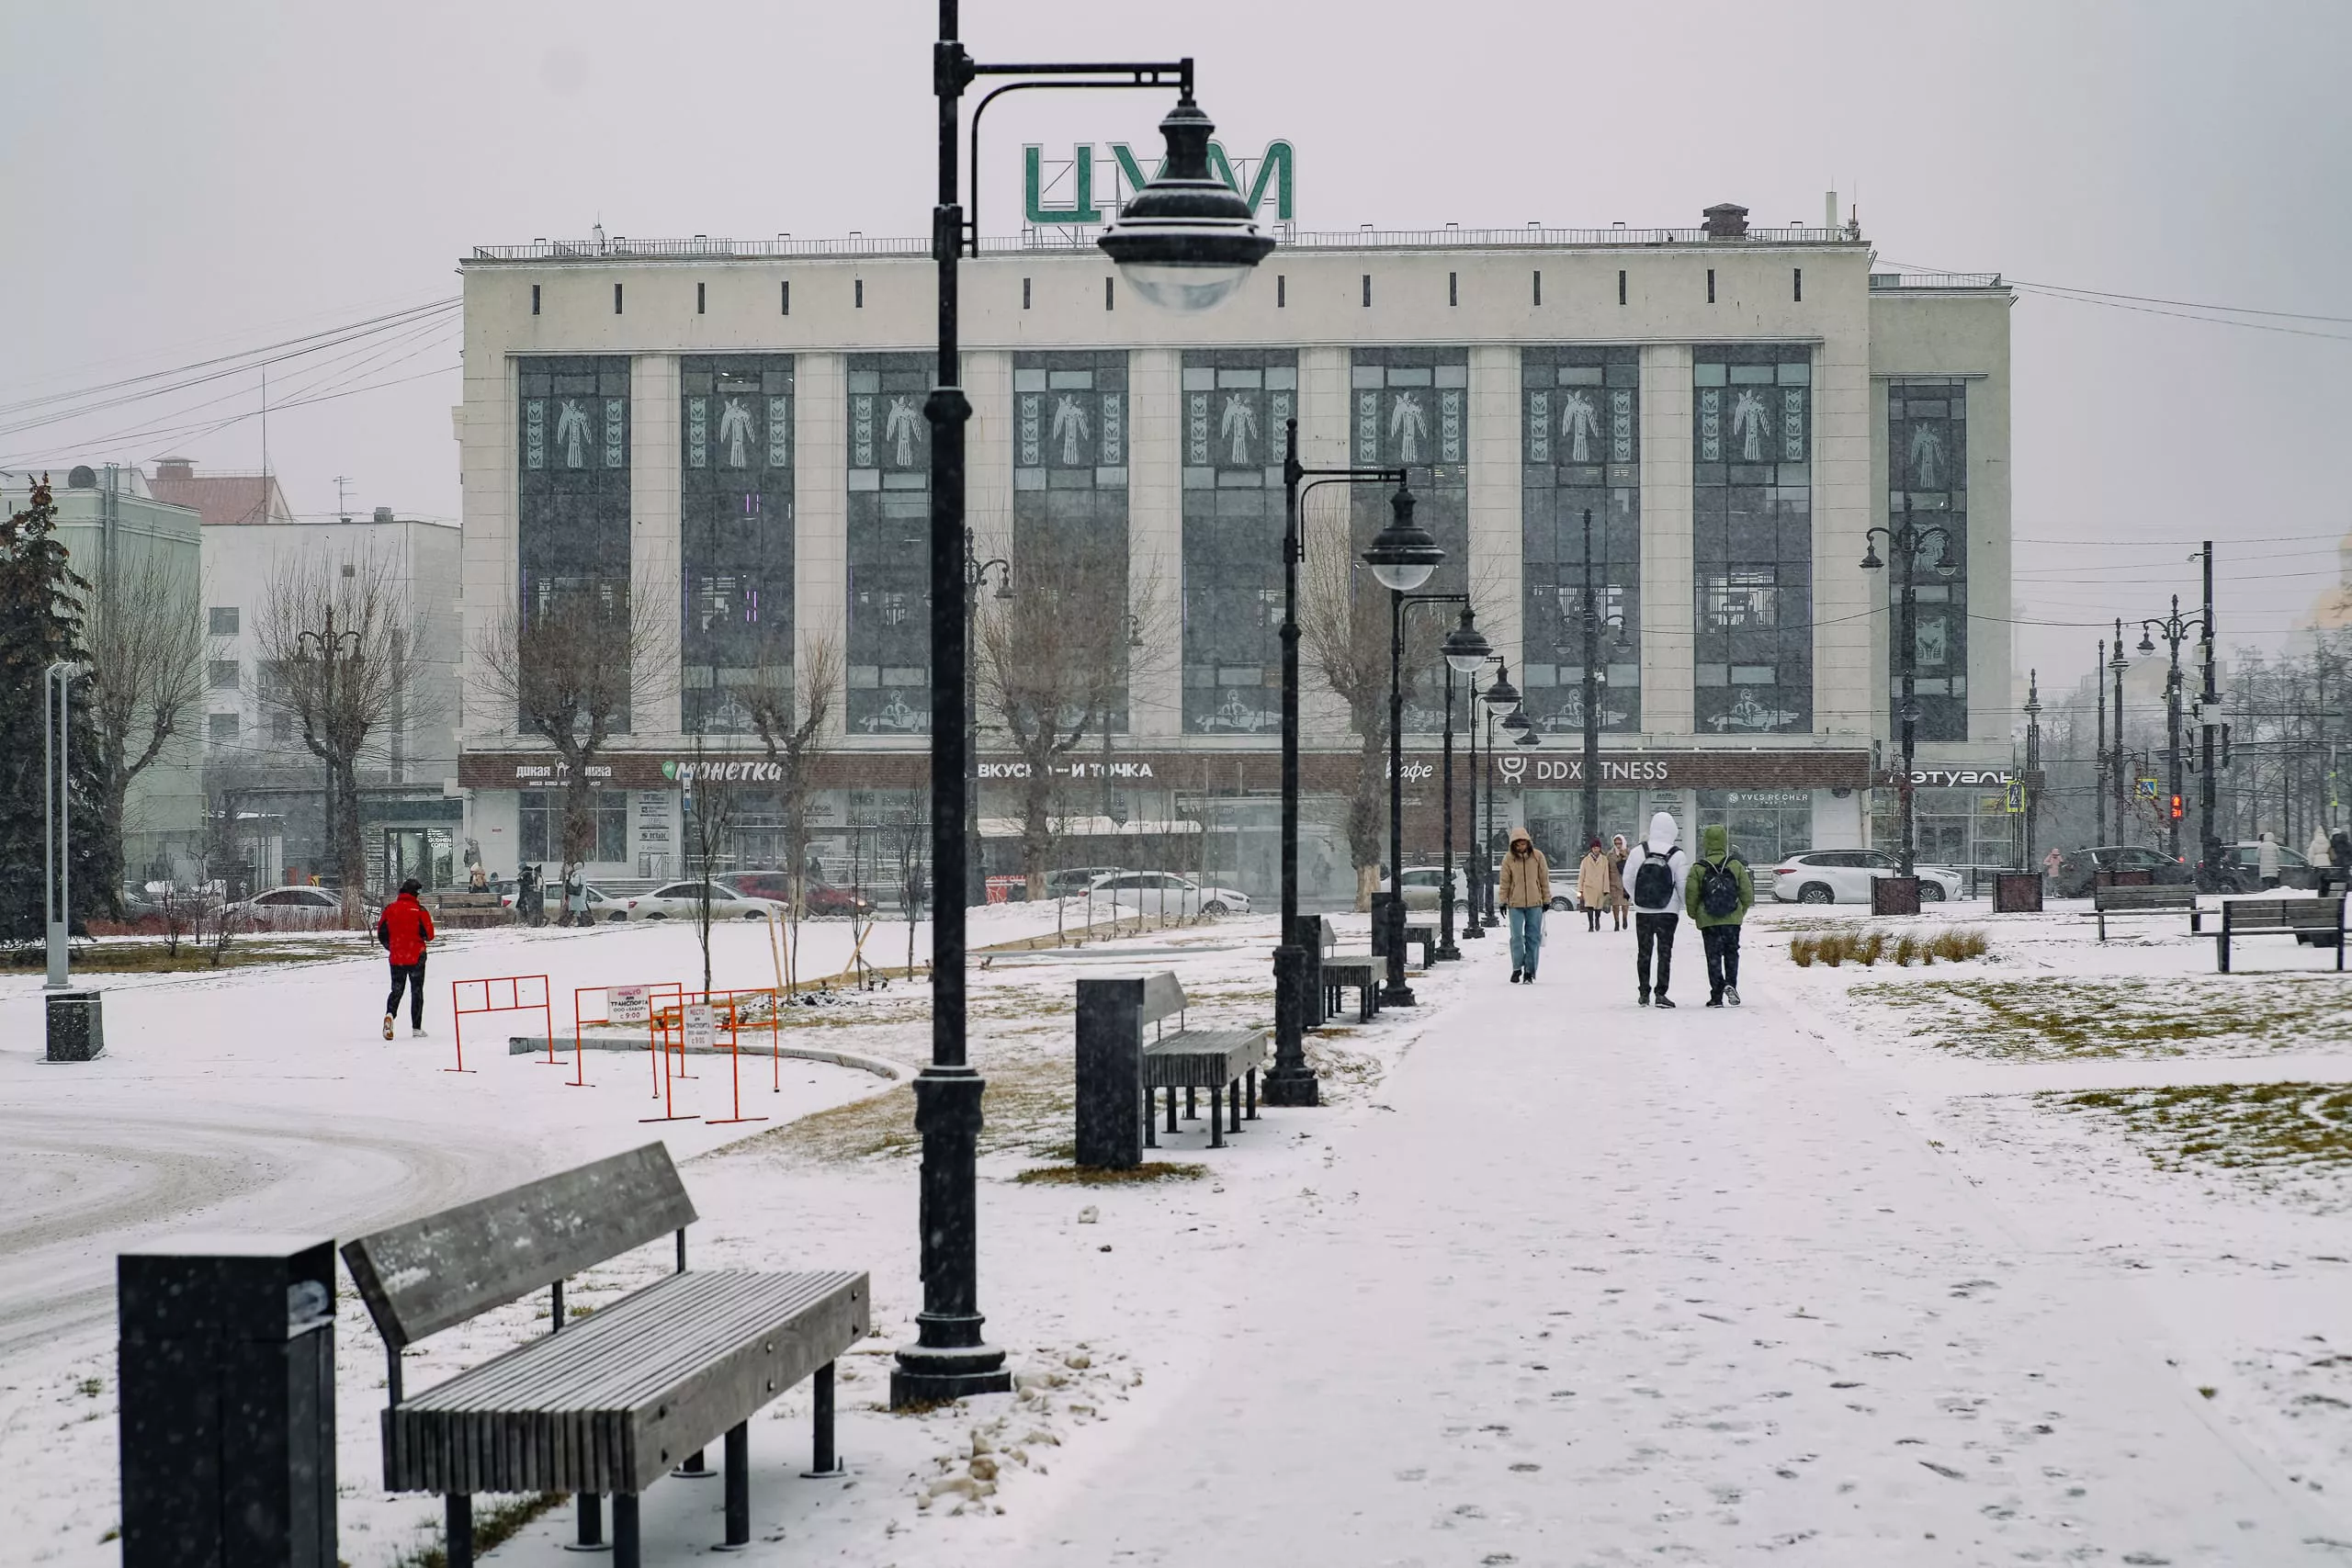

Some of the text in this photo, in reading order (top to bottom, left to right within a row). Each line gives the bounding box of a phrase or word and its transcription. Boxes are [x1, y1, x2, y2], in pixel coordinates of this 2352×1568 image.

[978, 763, 1053, 778] ВКУС
[1071, 763, 1084, 778] И
[1537, 761, 1668, 780] DDX TNESS
